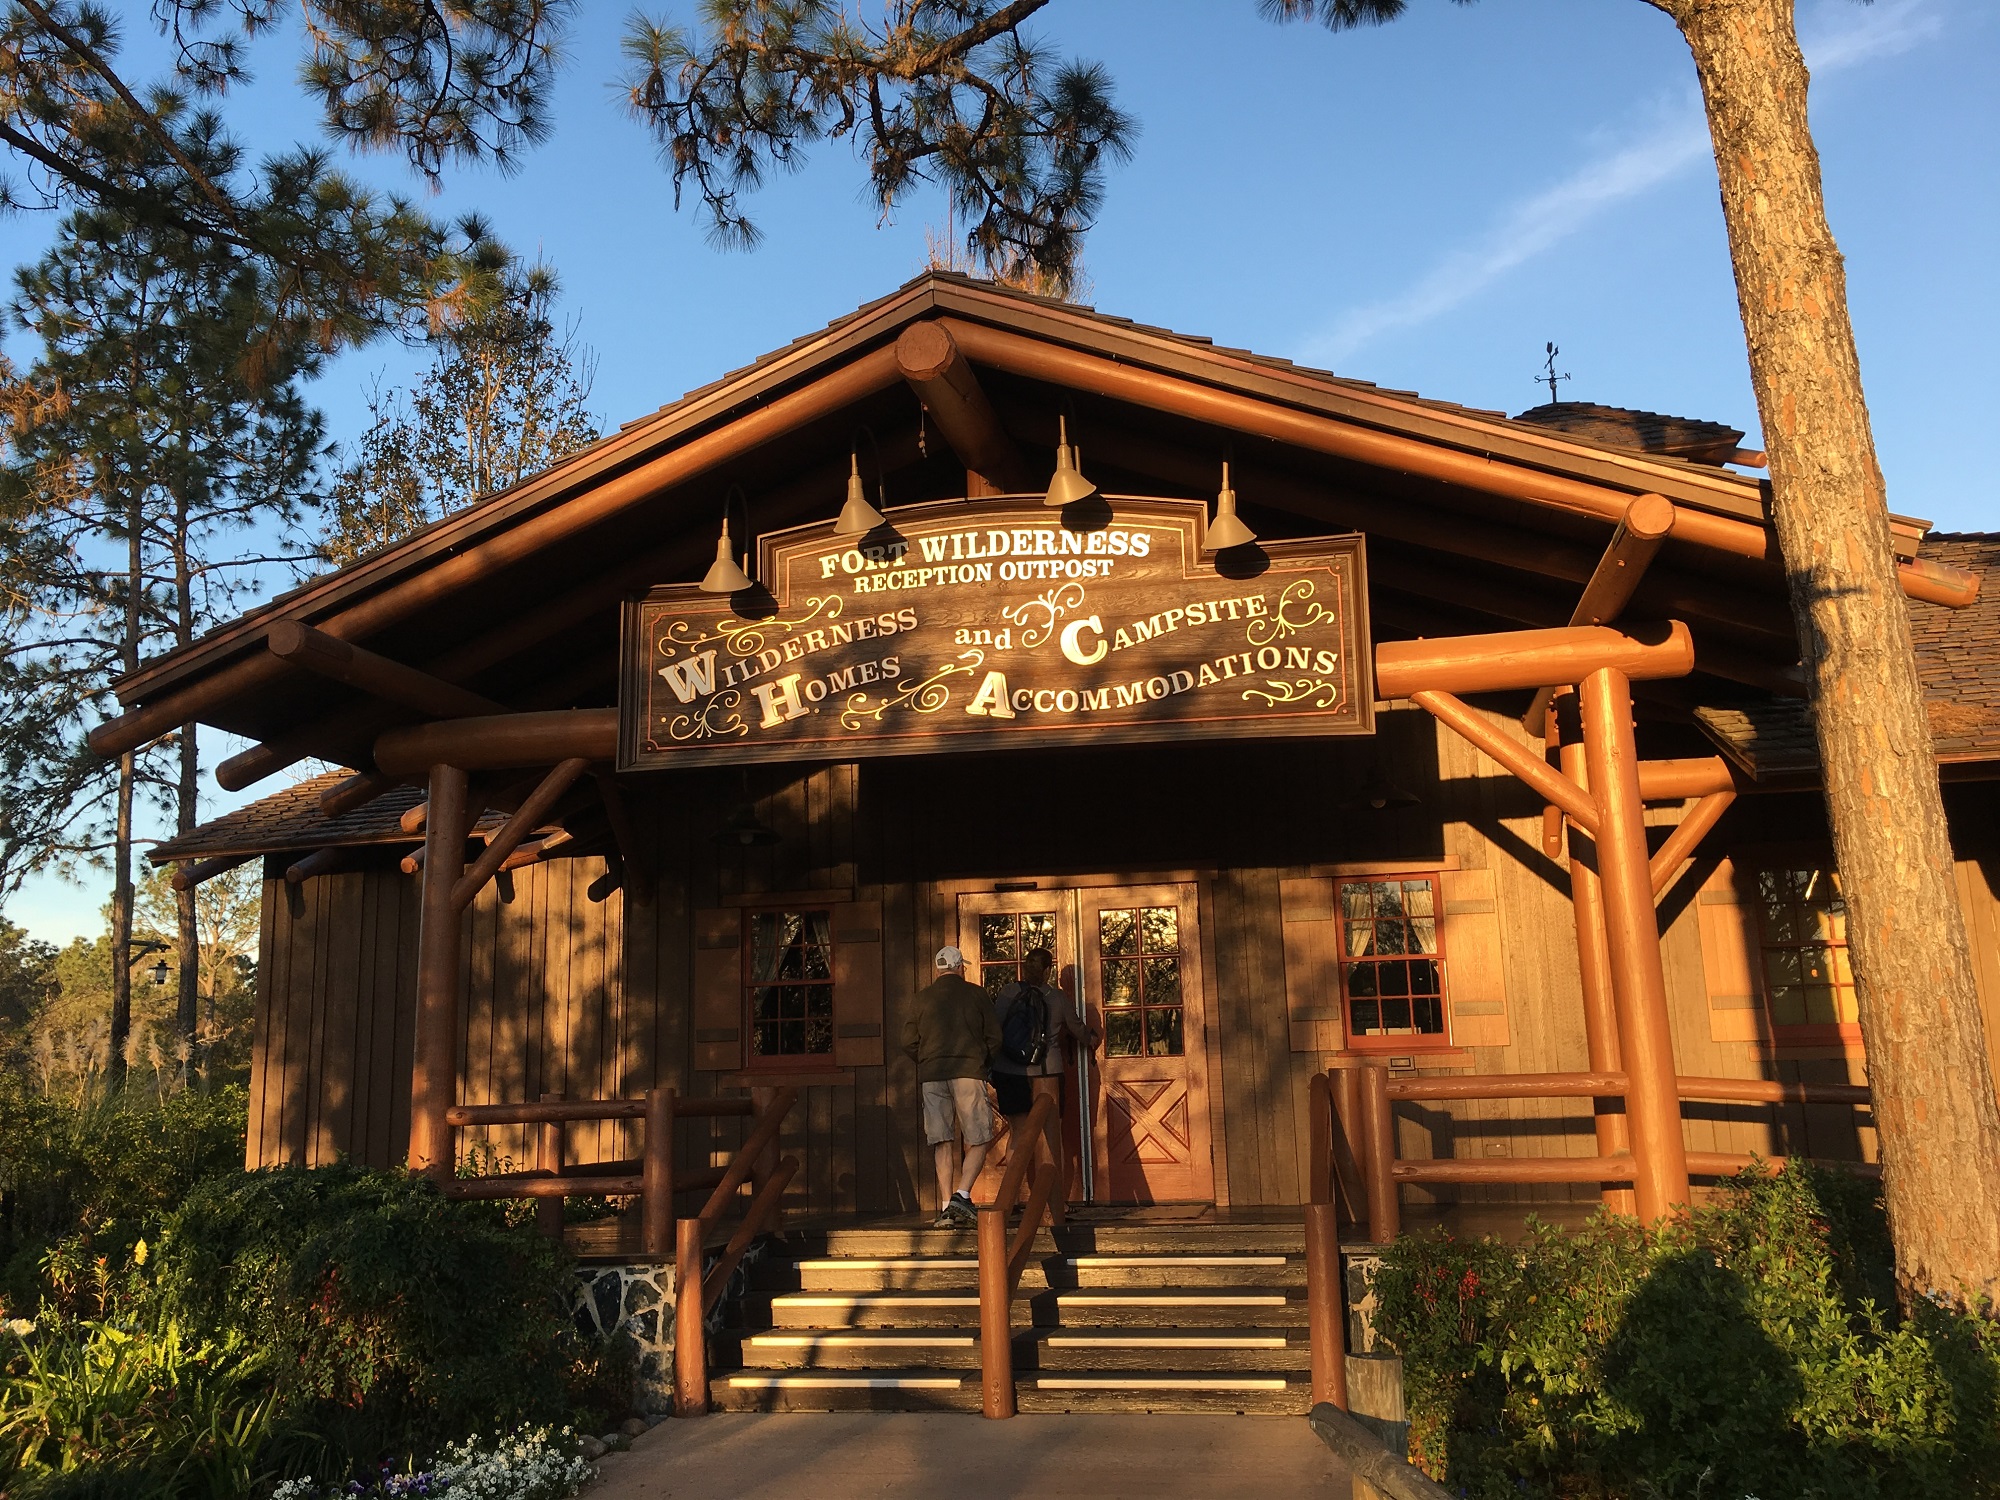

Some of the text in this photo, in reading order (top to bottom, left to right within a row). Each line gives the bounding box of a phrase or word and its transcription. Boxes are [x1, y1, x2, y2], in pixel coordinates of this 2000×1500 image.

[1534, 375, 1541, 383] S
[819, 529, 1151, 579] FORT WILDERNESS
[853, 558, 1114, 594] RECEPTION OUTPOST
[658, 607, 918, 704] WILDERNESS
[955, 628, 1013, 650] and
[1060, 594, 1268, 666] CAMPSITE
[750, 655, 901, 730] HOMES
[965, 646, 1339, 719] ACCOMMODATIONS
